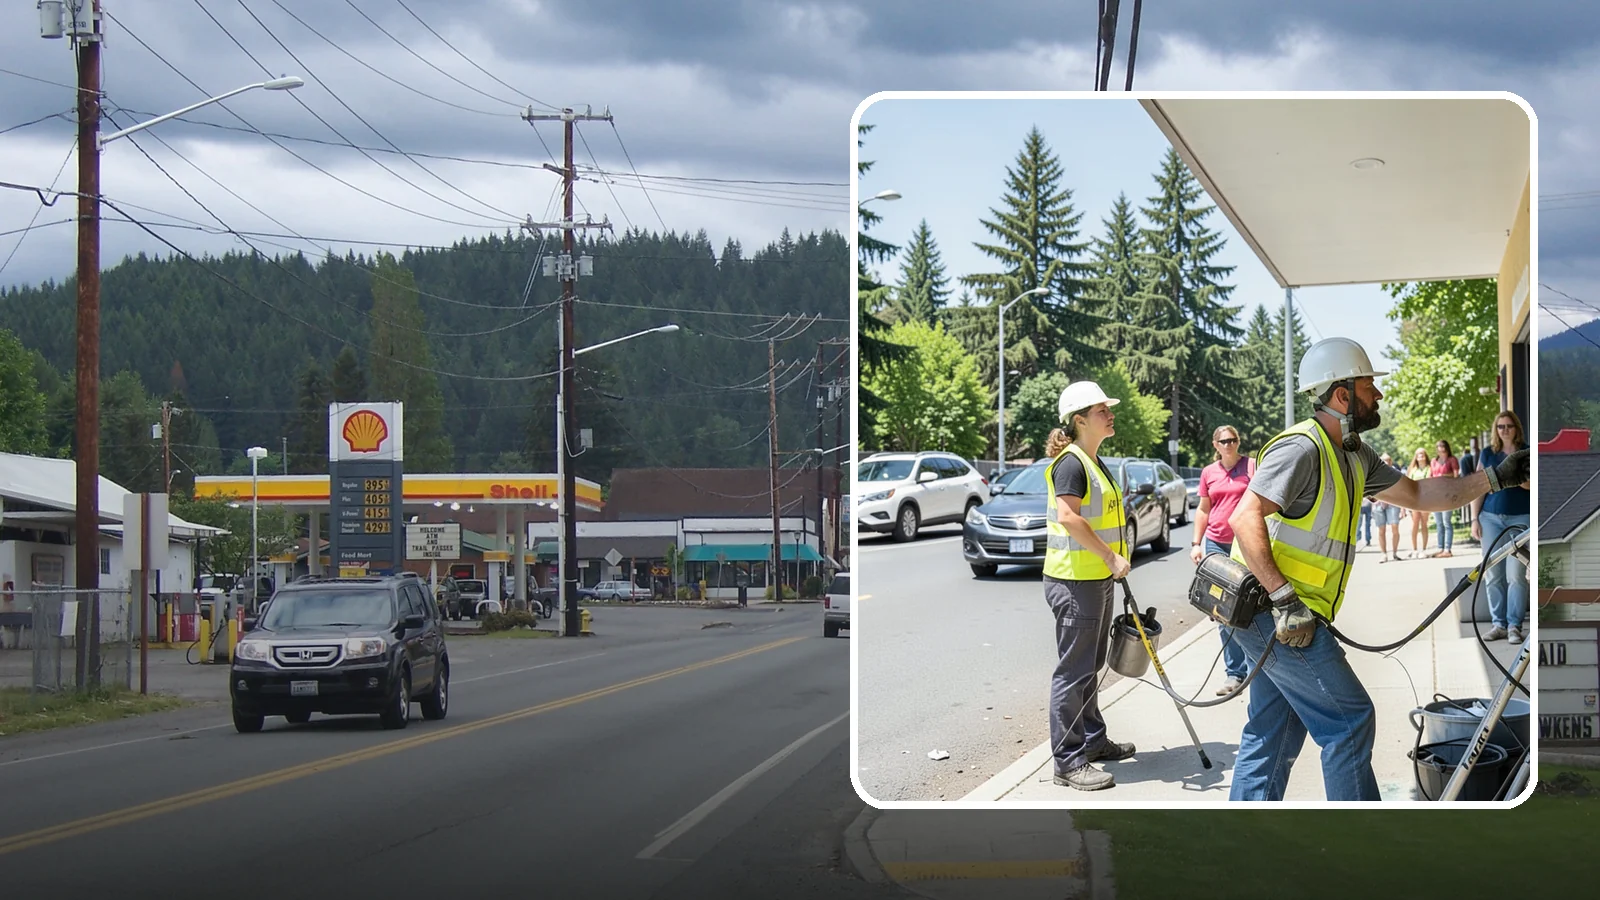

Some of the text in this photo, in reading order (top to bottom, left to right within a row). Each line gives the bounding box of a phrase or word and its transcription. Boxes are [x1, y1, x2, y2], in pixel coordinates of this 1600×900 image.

[366, 480, 384, 490] 395
[490, 484, 548, 499] Shell
[365, 494, 384, 504] 405
[365, 508, 383, 518] 415
[366, 522, 384, 533] 429
